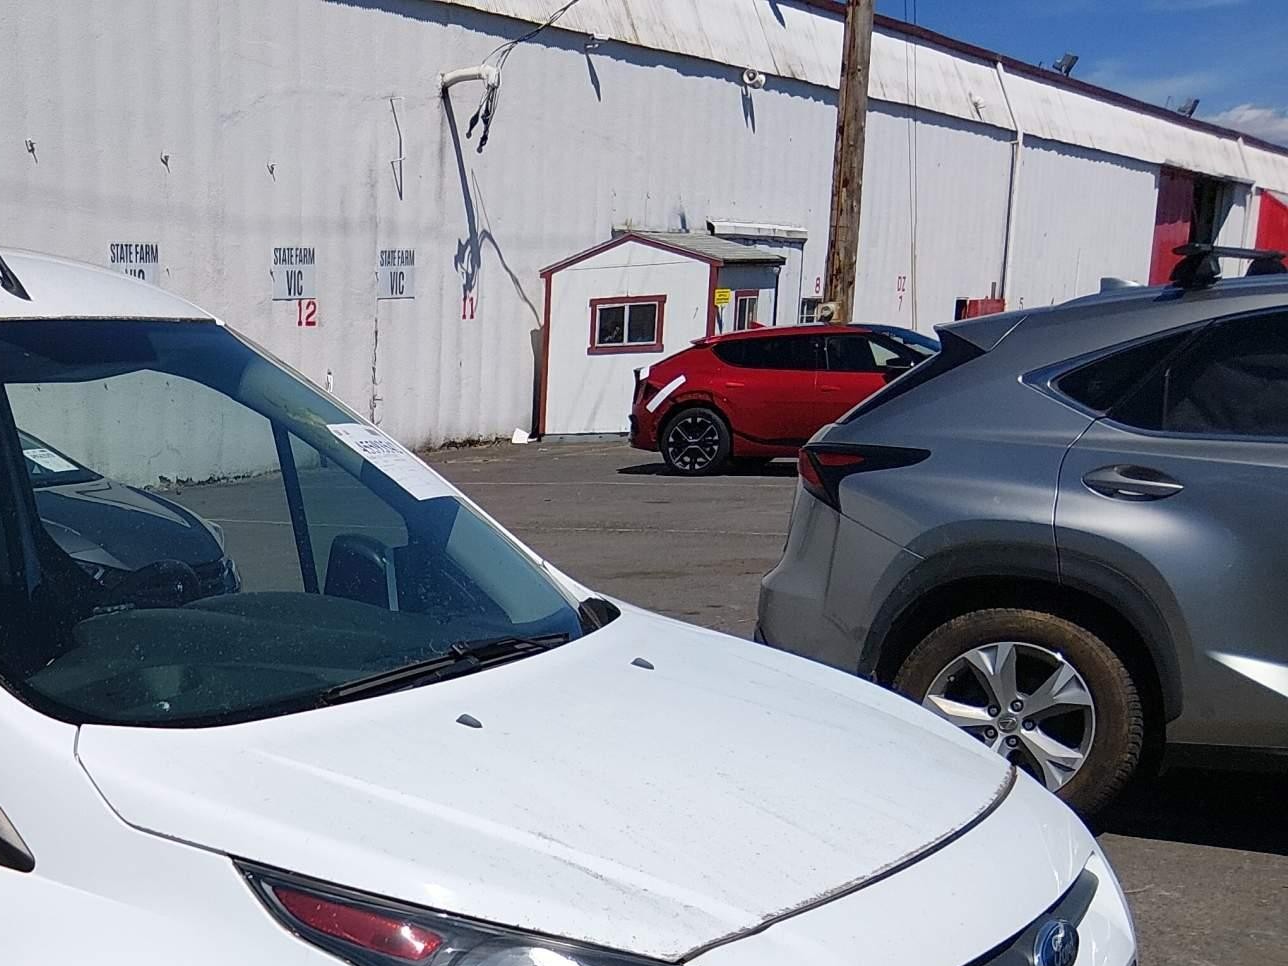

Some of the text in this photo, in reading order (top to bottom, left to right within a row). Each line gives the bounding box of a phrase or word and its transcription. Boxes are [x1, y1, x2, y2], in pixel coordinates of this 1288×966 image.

[110, 243, 159, 263] STATE FARM
[273, 247, 315, 265] STATE FARM
[380, 250, 415, 266] STATE FARM
[286, 269, 303, 296] VIC
[390, 271, 404, 295] VIC
[297, 300, 316, 326] 12
